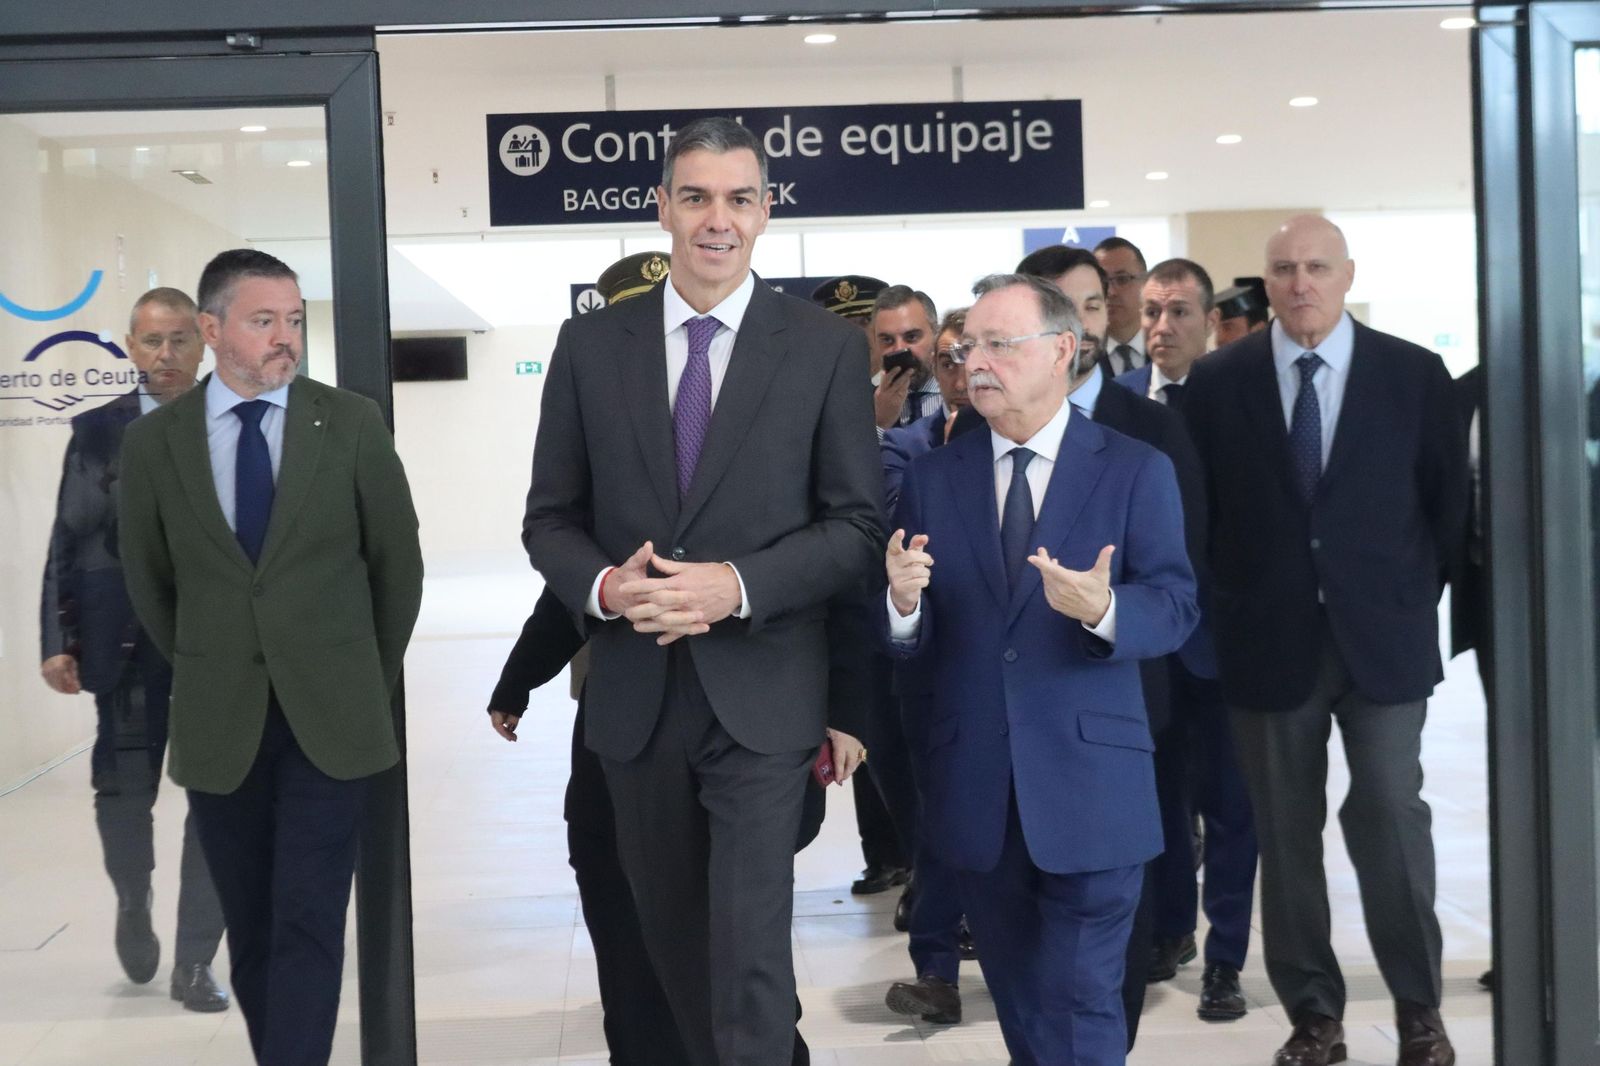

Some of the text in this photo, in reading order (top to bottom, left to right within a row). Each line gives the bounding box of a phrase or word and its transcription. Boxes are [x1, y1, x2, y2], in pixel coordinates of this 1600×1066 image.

[561, 109, 1053, 165] Cont de equipaje
[563, 186, 660, 212] BAGGA
[1062, 226, 1080, 244] A
[49, 369, 77, 386] de
[84, 368, 150, 386] Ceuta
